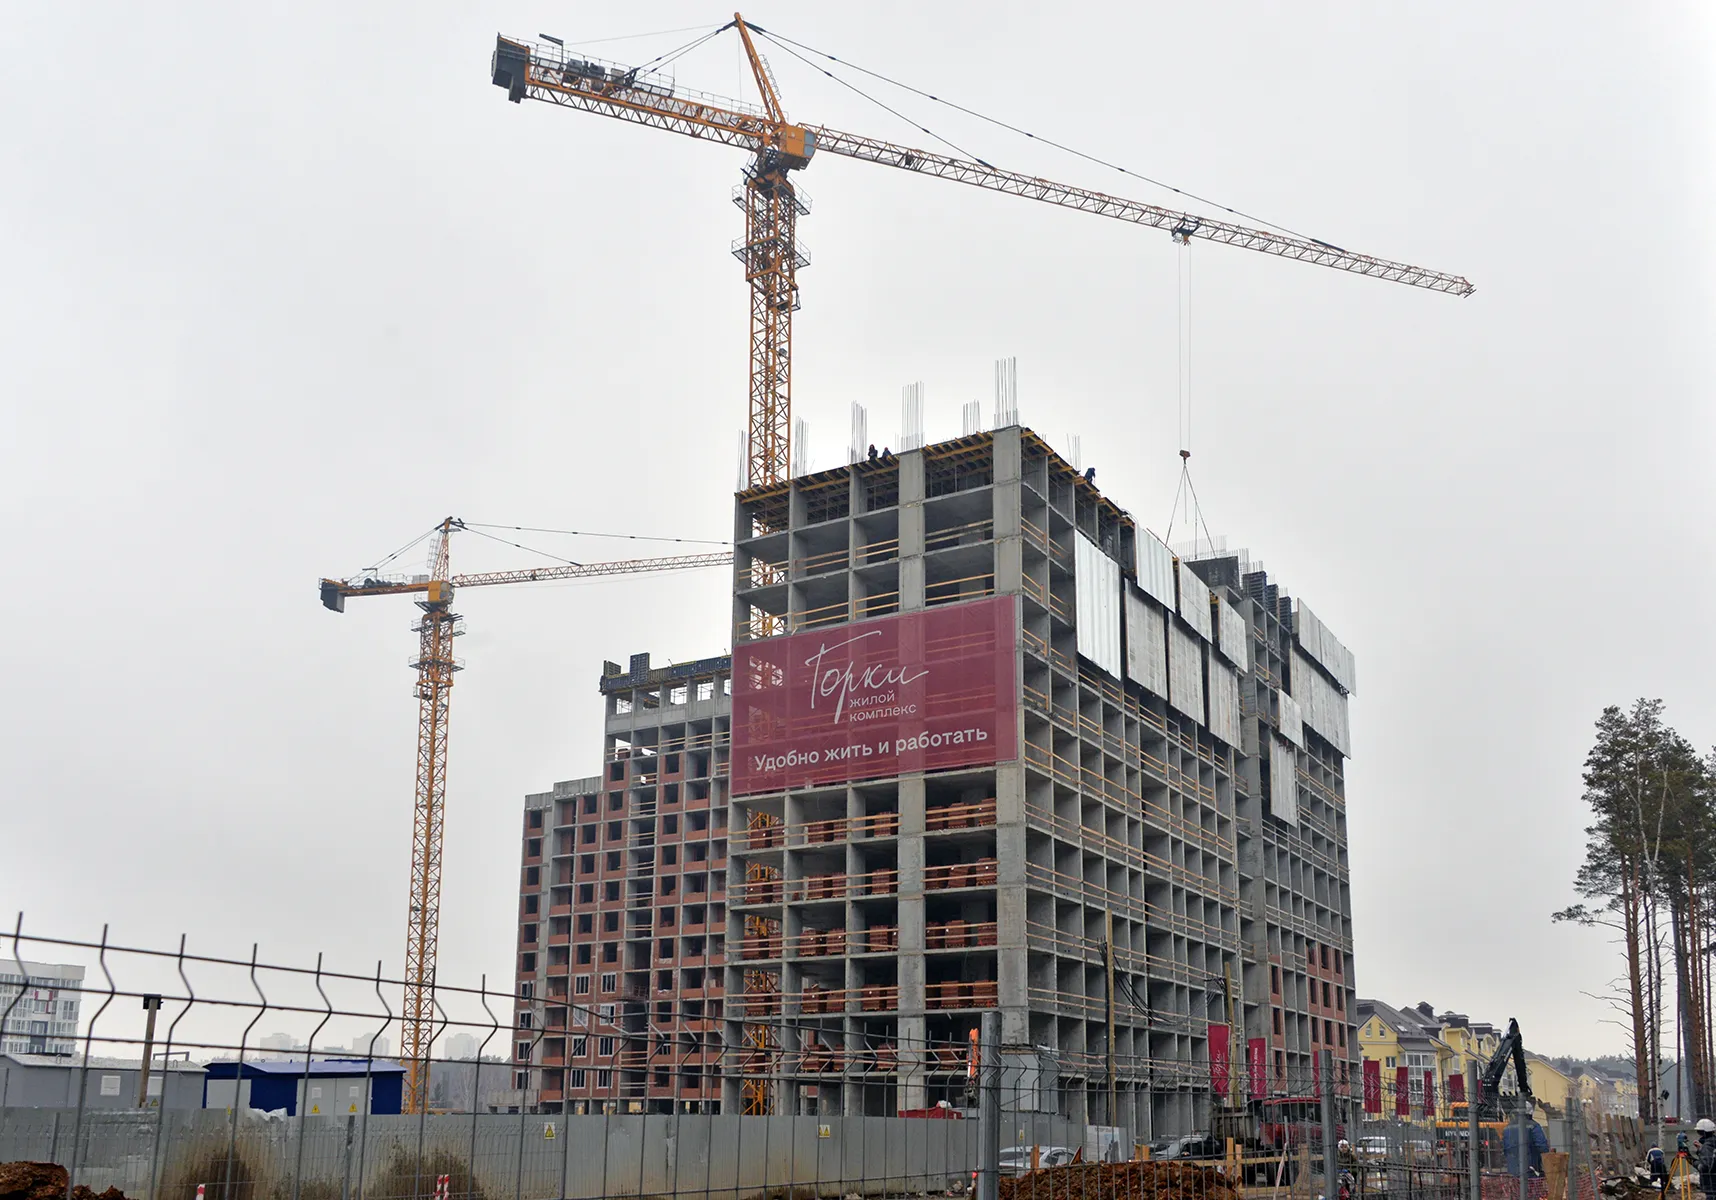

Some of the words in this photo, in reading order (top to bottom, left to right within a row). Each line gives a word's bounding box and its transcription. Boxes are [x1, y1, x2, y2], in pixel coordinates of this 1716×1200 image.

[804, 630, 929, 724] Горки
[849, 690, 895, 708] жилой
[849, 703, 917, 722] комплекс
[754, 750, 820, 772] Удобно
[825, 743, 872, 762] жить
[879, 742, 890, 753] и
[896, 727, 988, 756] работать
